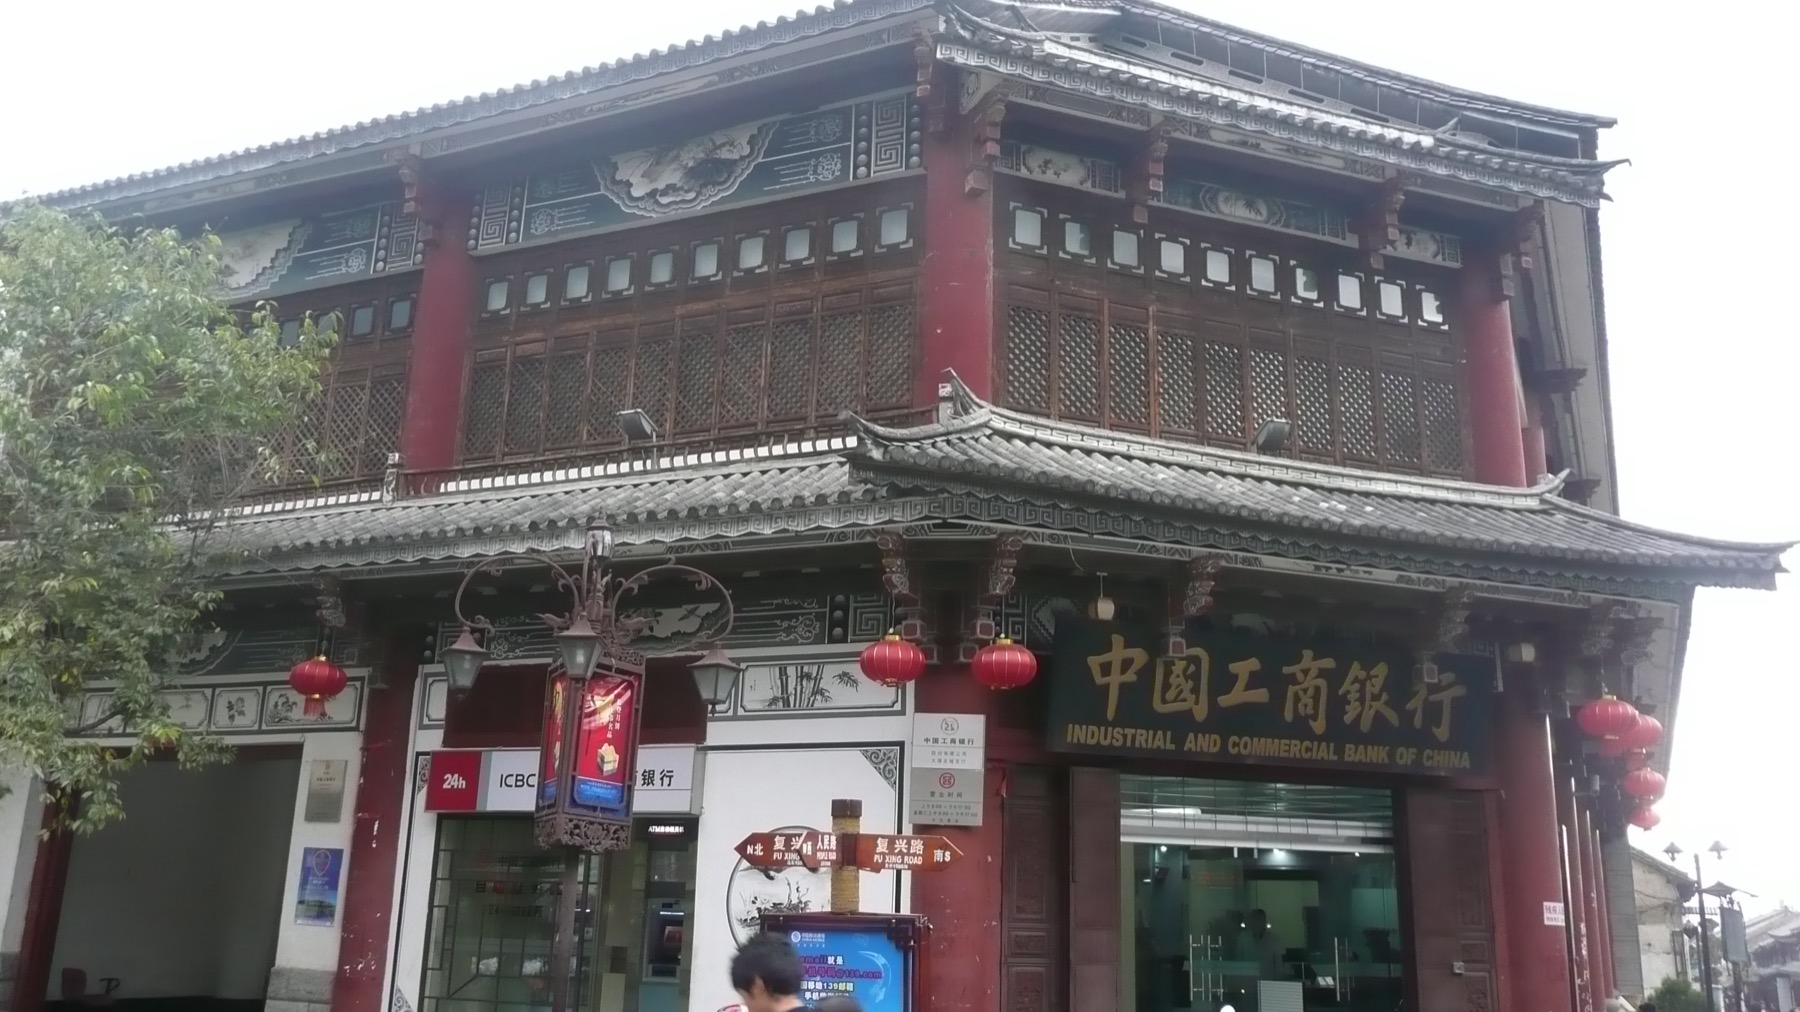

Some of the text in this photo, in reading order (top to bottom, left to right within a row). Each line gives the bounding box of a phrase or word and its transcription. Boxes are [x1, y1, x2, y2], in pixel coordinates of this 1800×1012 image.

[1087, 634, 1467, 742] 中國工商銀行
[924, 737, 975, 746] 中国工商银行
[1067, 724, 1471, 769] INDUSTRIAL AND COMMERCIAL BANK OF CHINA
[443, 773, 466, 789] 24h
[499, 773, 536, 788] ICBC
[816, 834, 837, 850] 人民路
[875, 837, 924, 855] 复兴路
[773, 851, 801, 861] FU XING
[873, 854, 923, 865] FU XING ROAD
